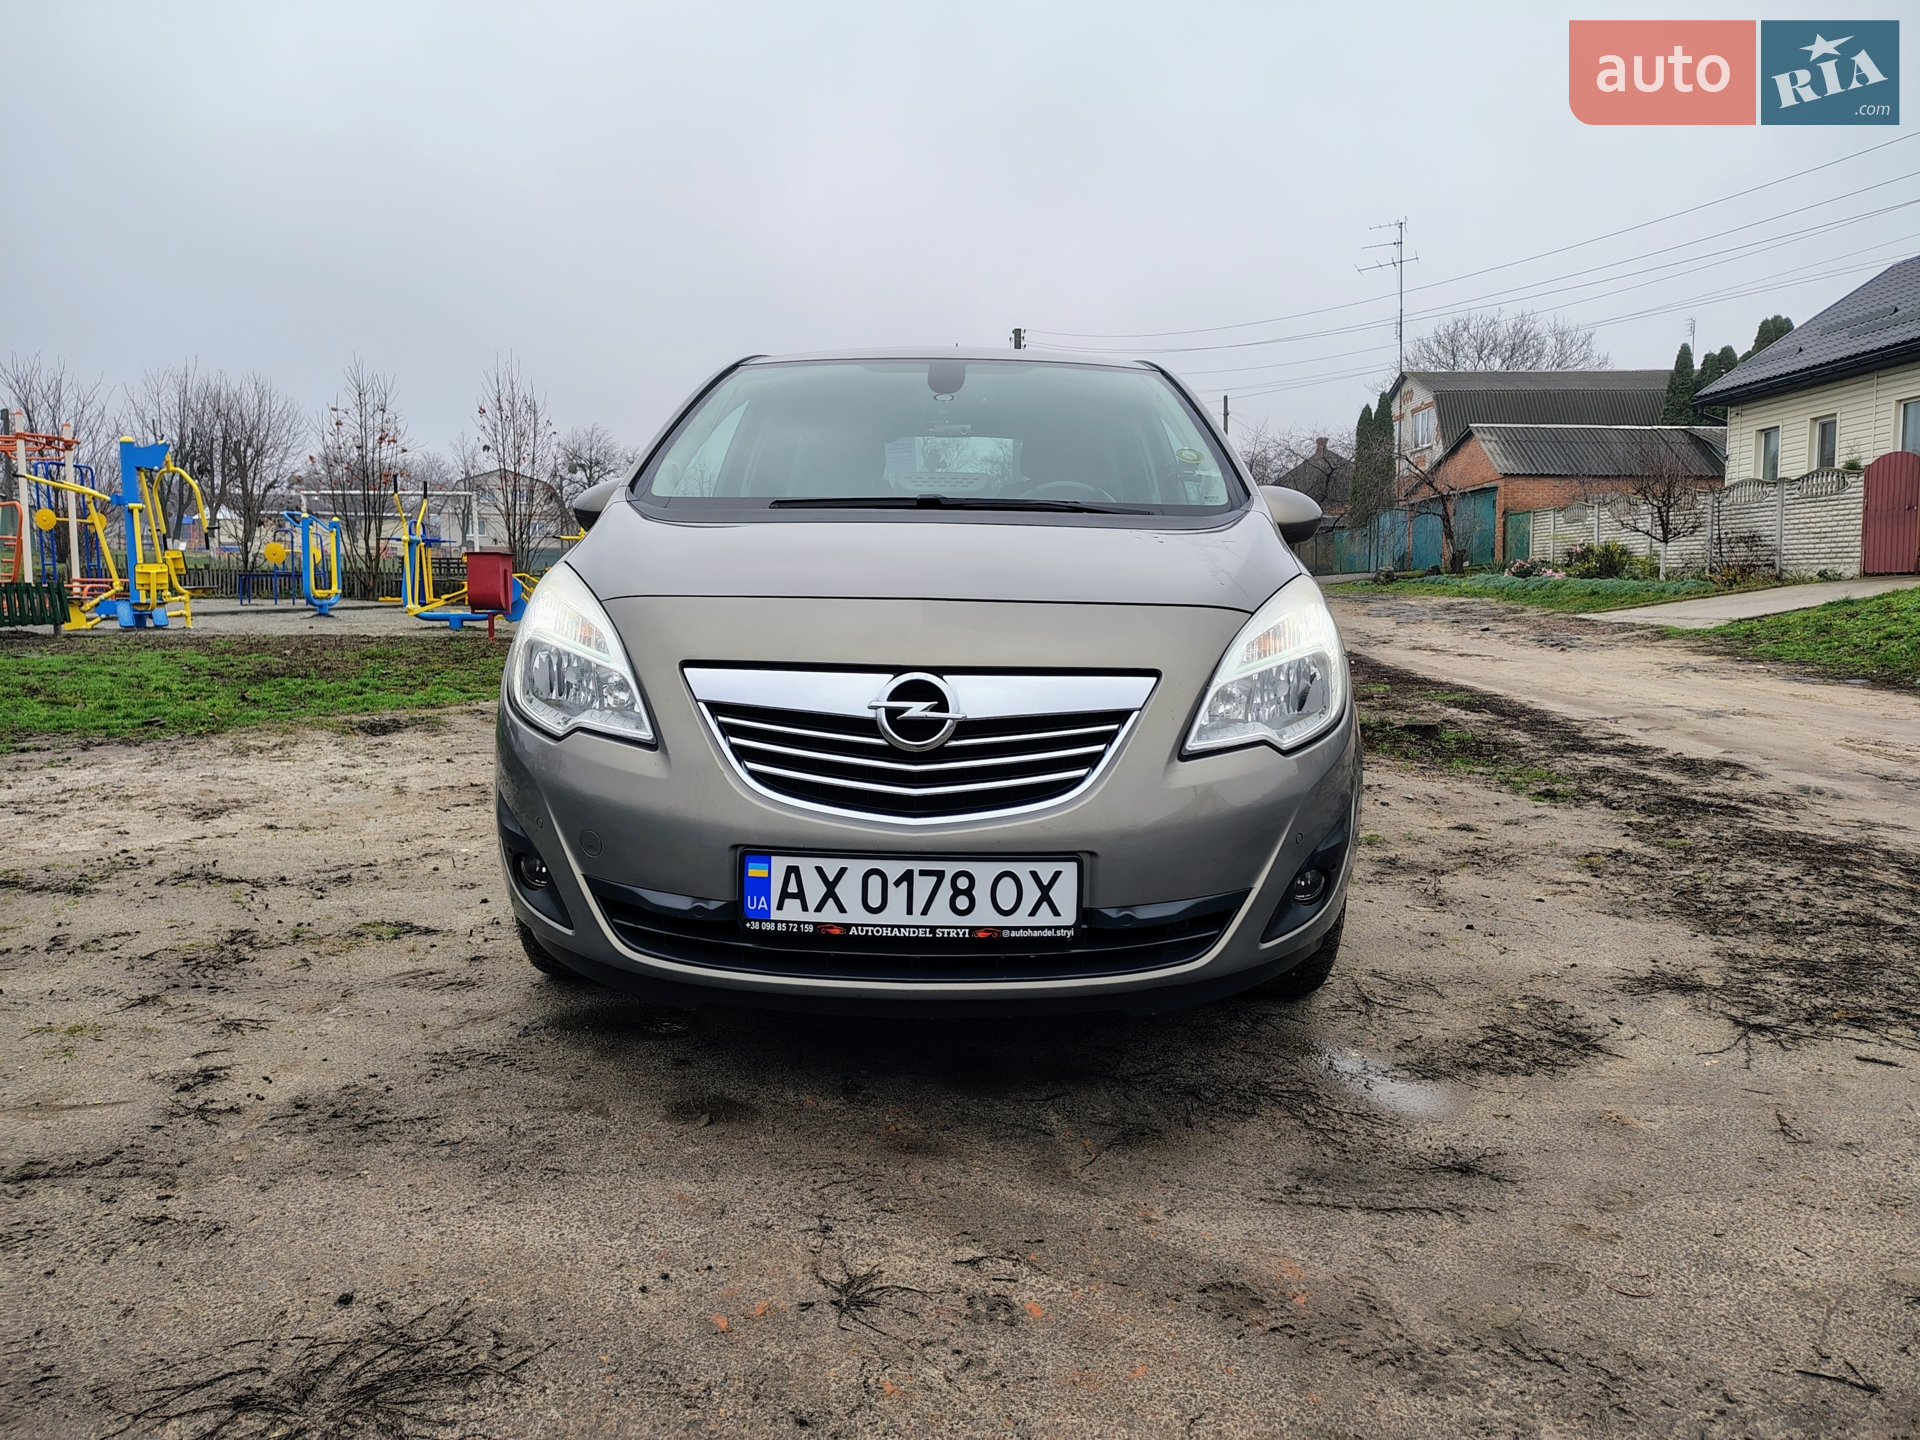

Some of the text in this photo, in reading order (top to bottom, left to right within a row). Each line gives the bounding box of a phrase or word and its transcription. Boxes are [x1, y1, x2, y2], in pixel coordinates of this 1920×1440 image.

[776, 864, 1064, 918] AX 0178 OX
[747, 895, 769, 911] UA
[745, 921, 814, 933] +38 098 85 72 159
[849, 926, 970, 938] AUTOHANDEL STRYI
